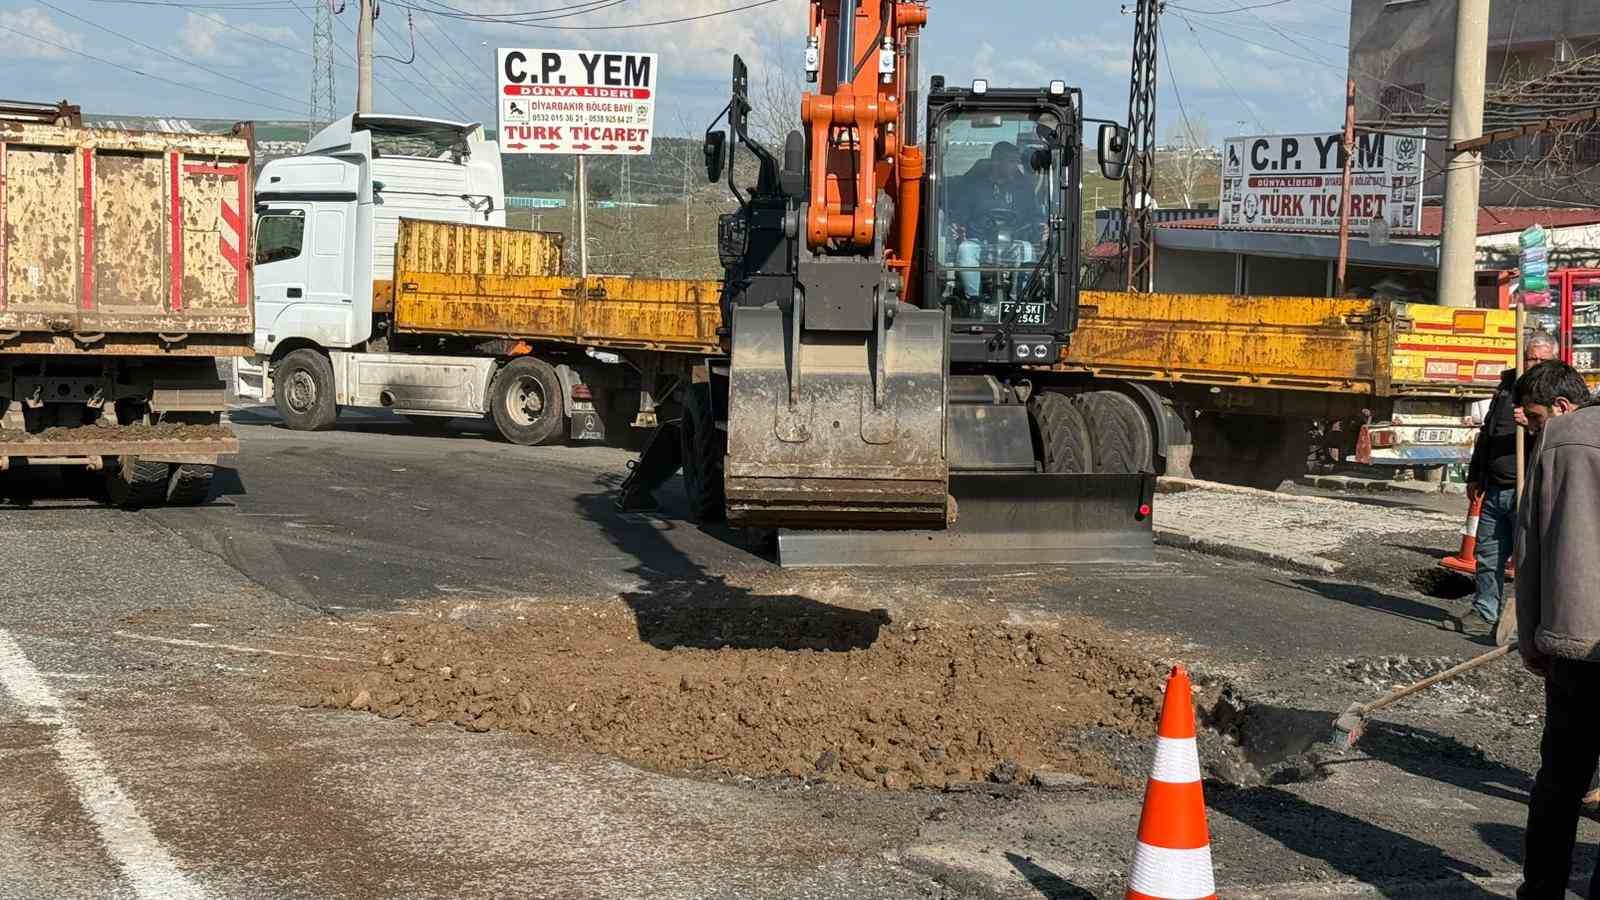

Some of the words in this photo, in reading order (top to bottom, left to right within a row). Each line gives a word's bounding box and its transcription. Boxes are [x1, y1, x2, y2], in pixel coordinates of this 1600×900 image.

[504, 51, 566, 84] C.P.
[578, 53, 651, 87] YEM
[520, 86, 578, 96] DÜNYA
[531, 100, 584, 111] DİYARBAKIR
[504, 122, 562, 140] TÜRK
[569, 122, 649, 142] TİCARET
[1250, 138, 1301, 171] C.P.
[1257, 177, 1286, 187] DÜNYA
[1260, 188, 1304, 217] TÜRK
[1310, 188, 1387, 218] TİCRET
